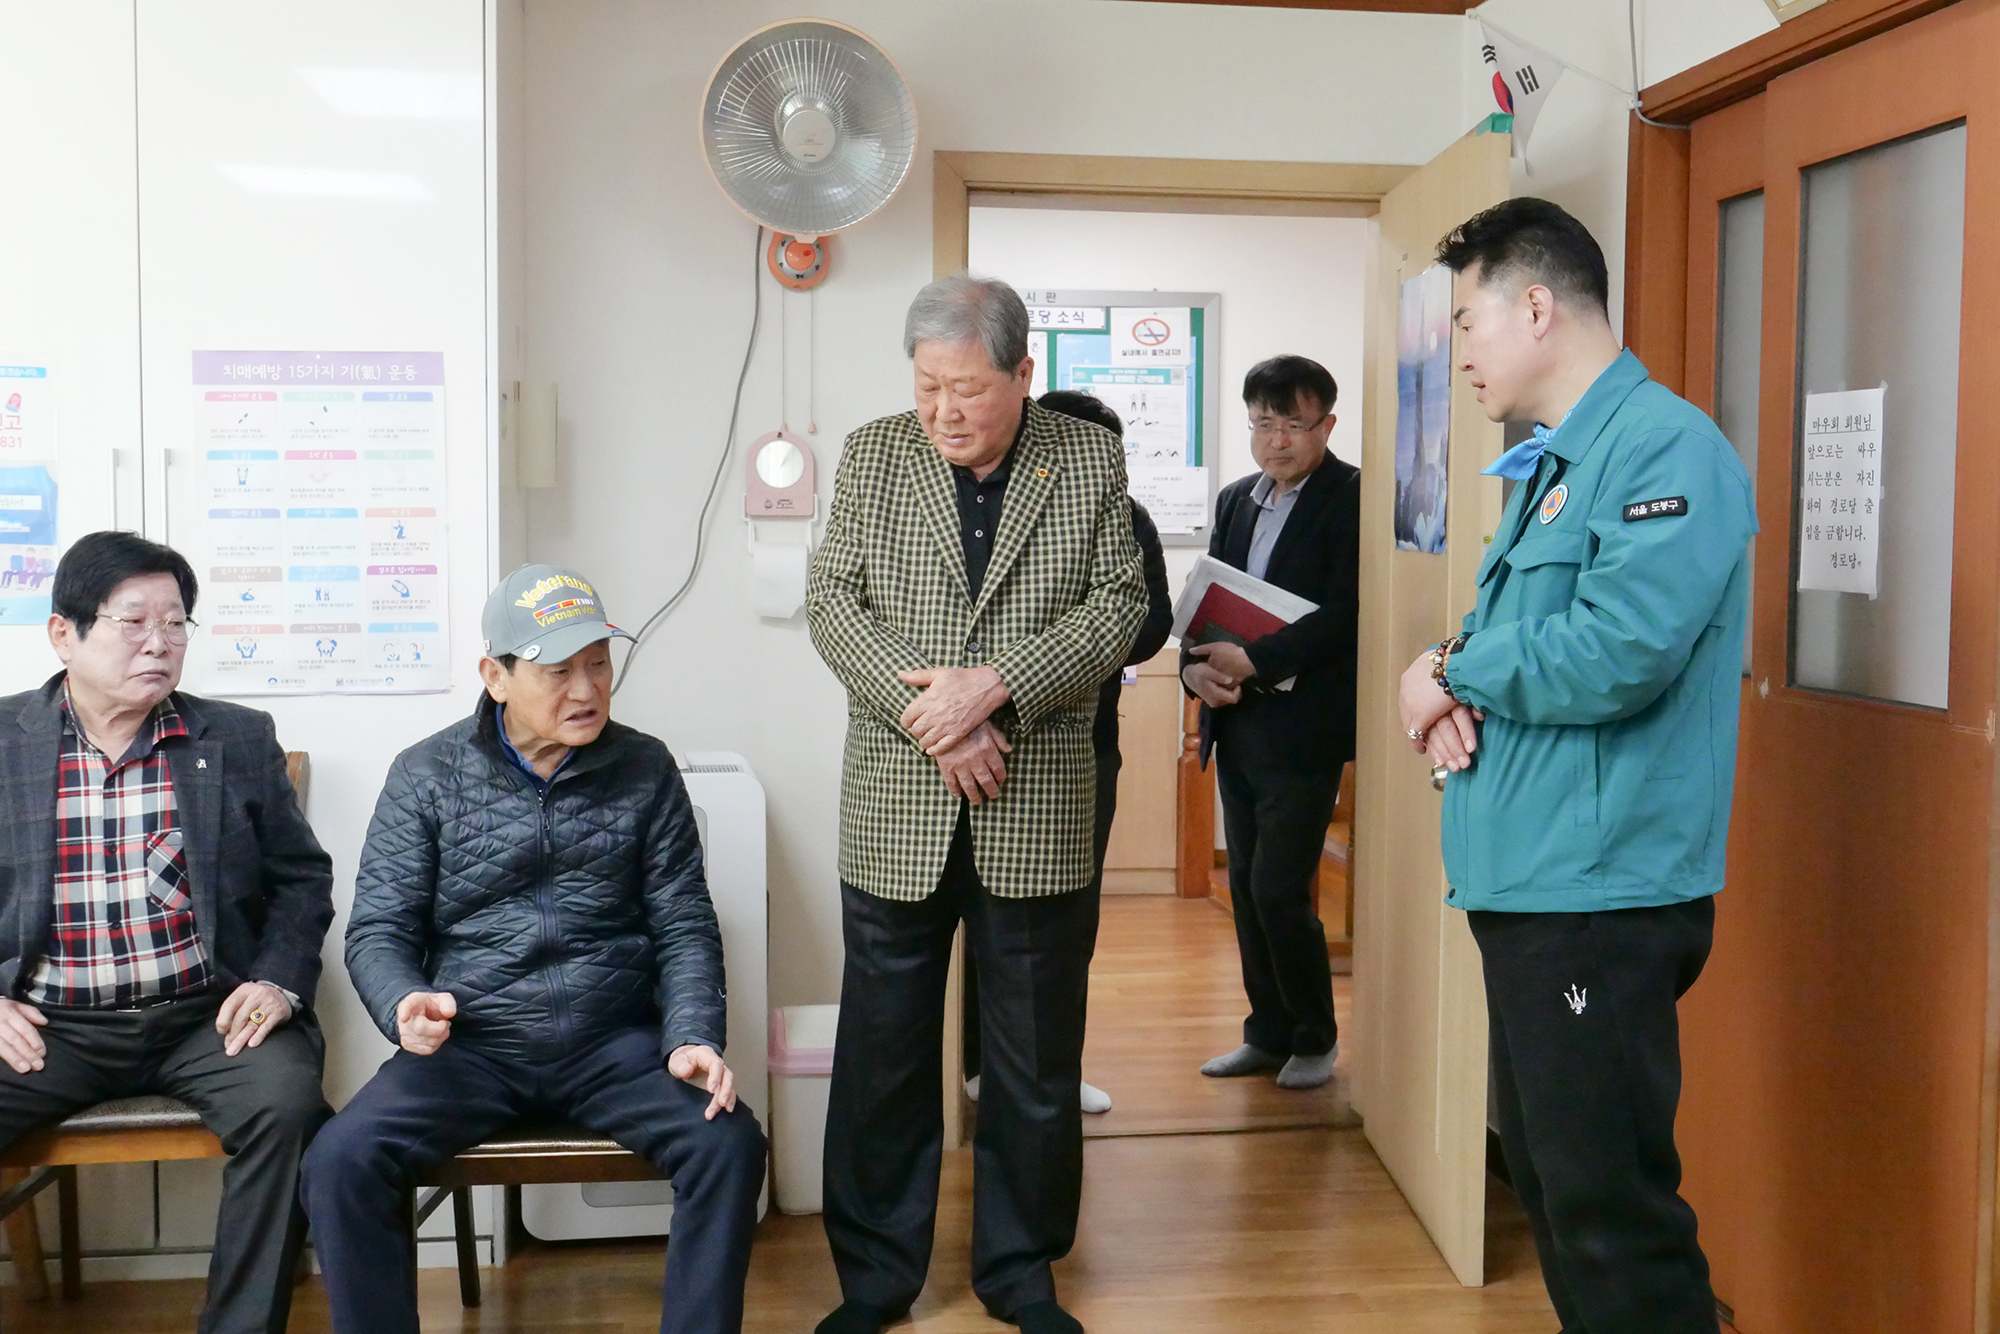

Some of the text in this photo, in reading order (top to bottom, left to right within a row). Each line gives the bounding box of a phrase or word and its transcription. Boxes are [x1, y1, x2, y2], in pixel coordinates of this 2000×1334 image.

[1057, 311, 1084, 324] 소식
[222, 363, 418, 382] 치매예방 15가지 기(氣) 운동
[0, 412, 23, 432] 고
[1812, 413, 1872, 433] 마우회 회원님
[1807, 442, 1876, 460] 앞으로는 싸우
[1807, 469, 1875, 487] 시는분은 자진
[1629, 500, 1679, 516] 서울 도봉구
[1806, 497, 1874, 515] 하여 경로당 출
[1805, 524, 1867, 542] 입을 금합니다.
[1830, 551, 1857, 570] 경로당
[514, 574, 593, 609] Veterans
[536, 607, 582, 628] Vietnam
